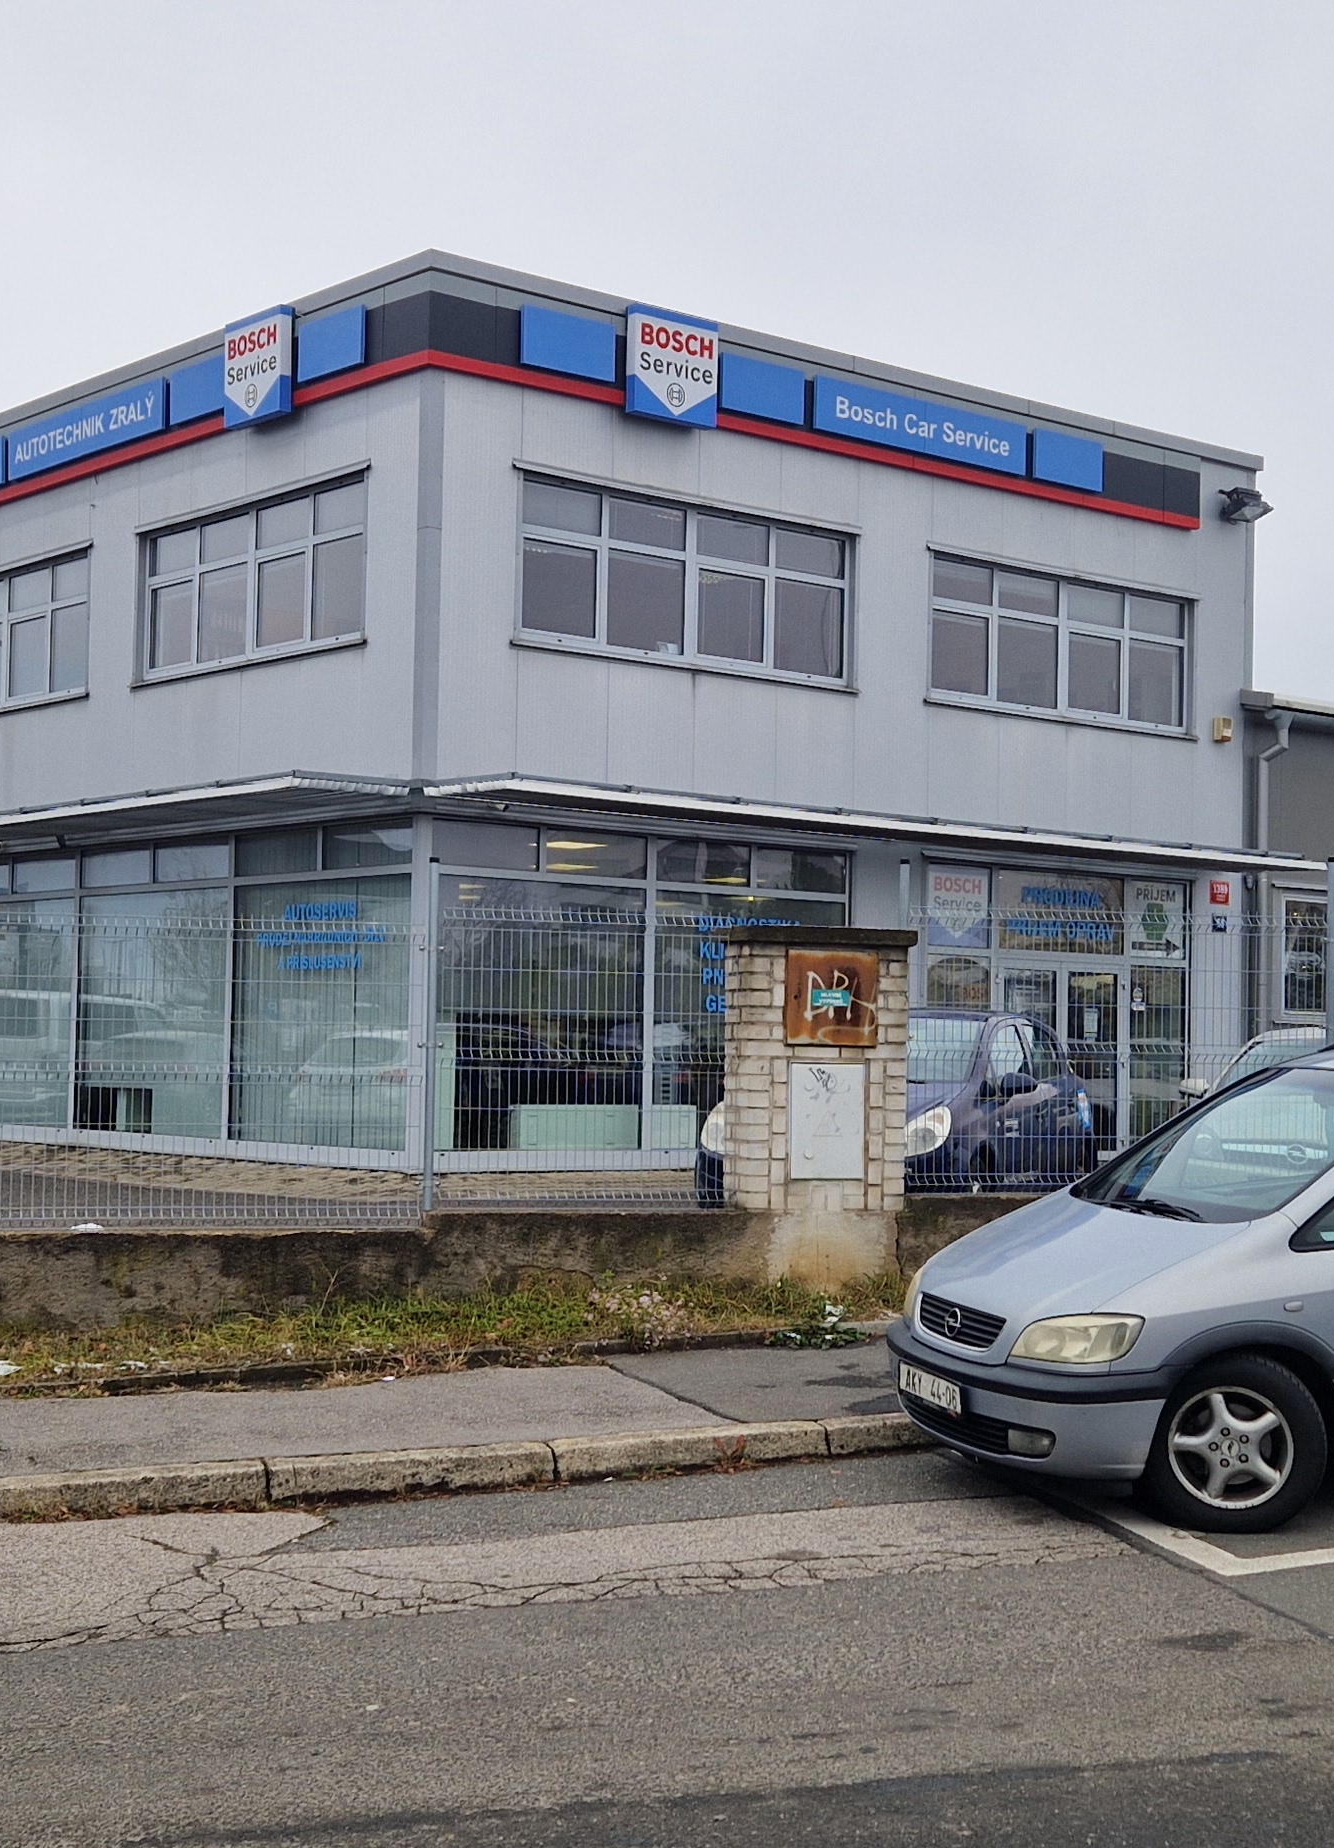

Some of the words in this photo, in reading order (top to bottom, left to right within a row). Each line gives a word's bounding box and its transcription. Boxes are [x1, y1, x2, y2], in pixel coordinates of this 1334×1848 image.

[228, 323, 277, 361] BOSCH
[640, 322, 714, 360] BOSCH
[227, 354, 277, 385] Service
[639, 352, 713, 385] Service
[14, 413, 105, 464] AUTOTECHNIK
[109, 391, 155, 430] ZRALÝ
[835, 396, 897, 431] Bosch
[904, 414, 938, 440] Car
[942, 421, 1010, 456] Service
[933, 876, 982, 895] BOSCH
[1136, 884, 1176, 903] PŘÍJEM
[284, 901, 358, 921] AUTOSERVIS
[933, 895, 982, 912] Service
[1067, 920, 1115, 940] OPRAV
[905, 1368, 923, 1394] AKY
[930, 1378, 958, 1410] 44-06
